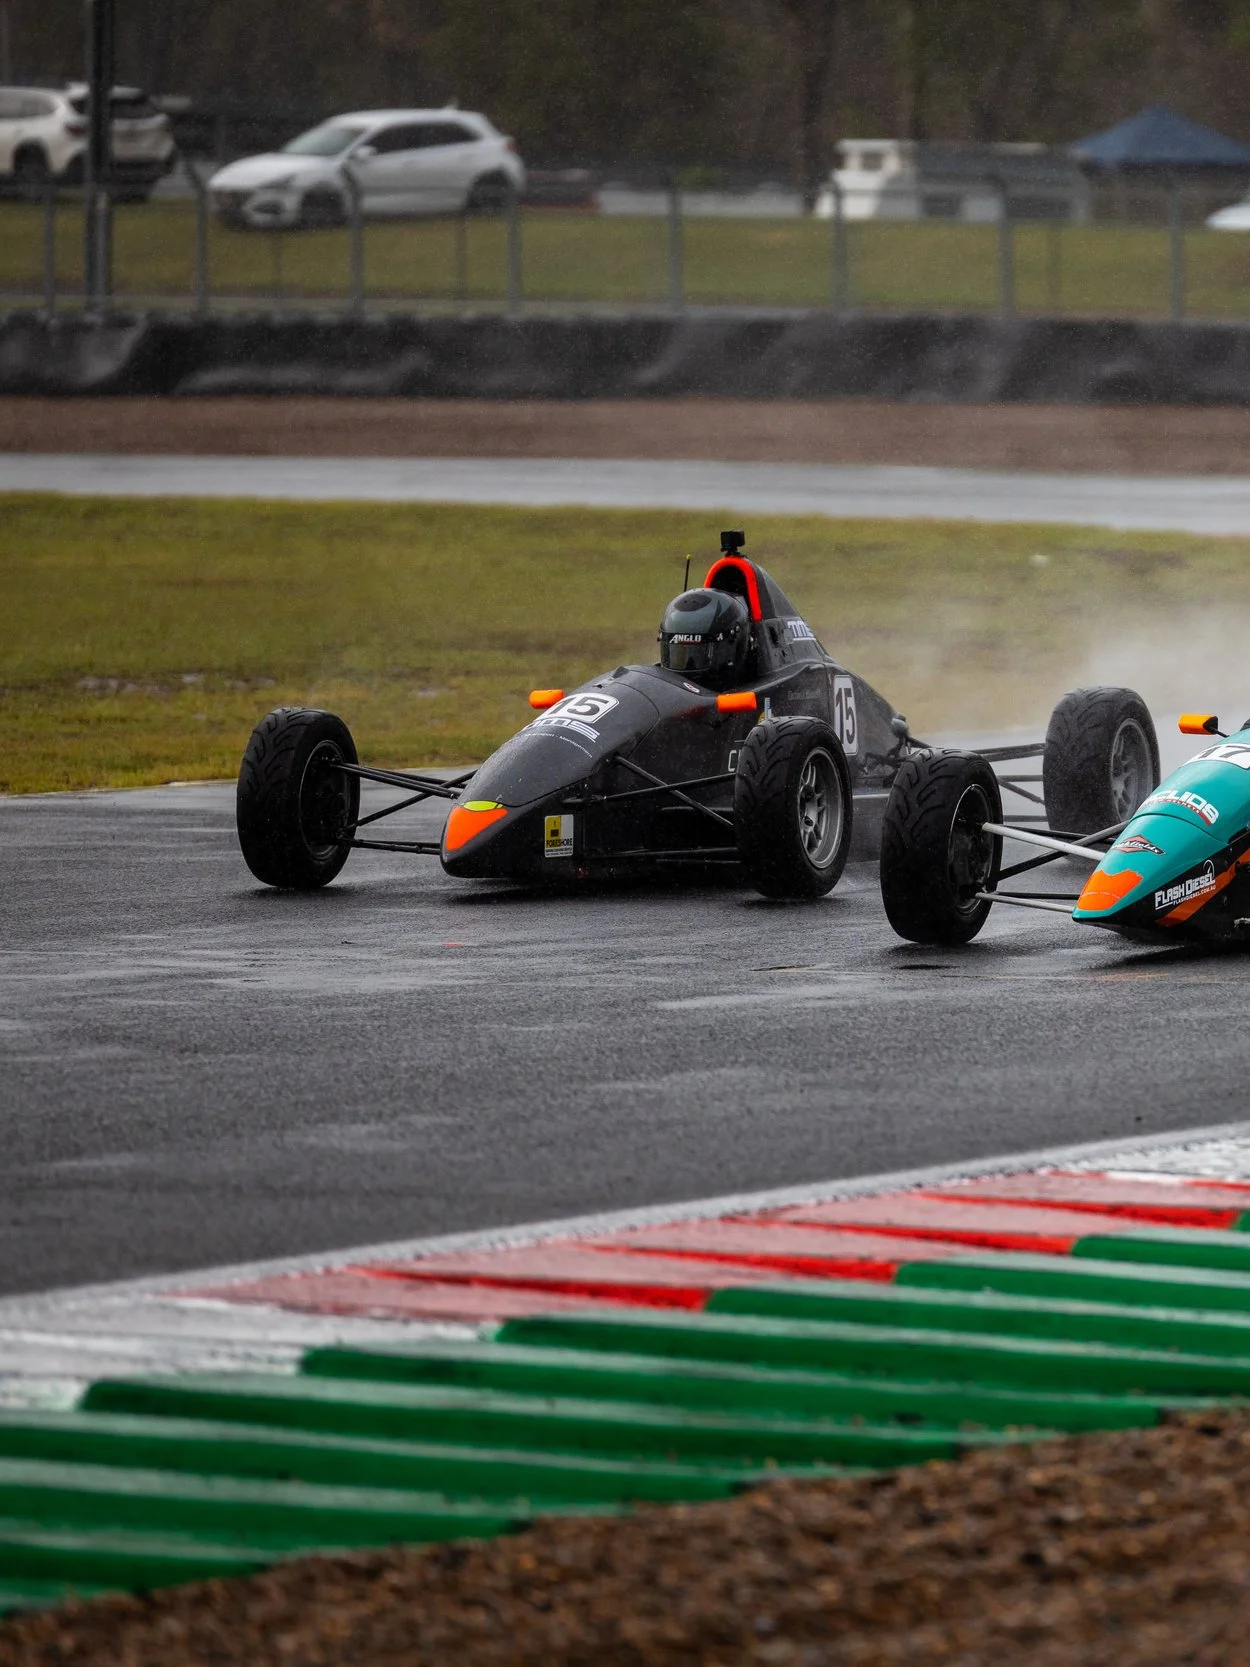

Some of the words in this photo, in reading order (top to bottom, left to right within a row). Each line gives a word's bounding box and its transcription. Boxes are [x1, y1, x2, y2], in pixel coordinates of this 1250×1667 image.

[669, 634, 702, 644] ANGLO
[547, 696, 610, 717] 15
[835, 687, 856, 745] 15
[1155, 883, 1186, 908] FLASH
